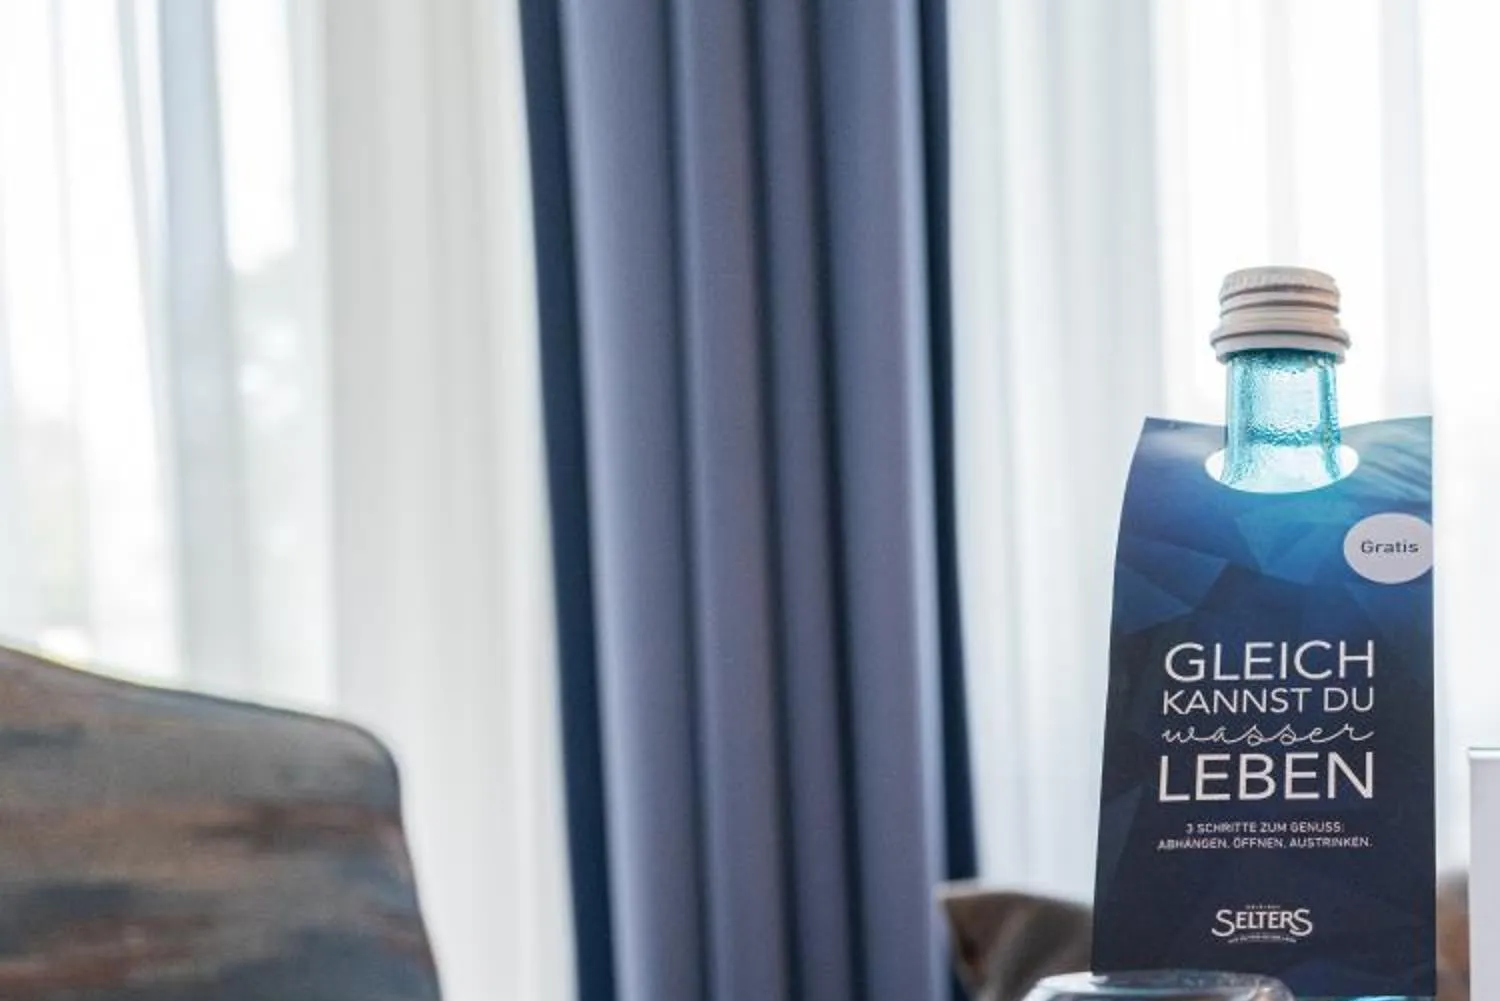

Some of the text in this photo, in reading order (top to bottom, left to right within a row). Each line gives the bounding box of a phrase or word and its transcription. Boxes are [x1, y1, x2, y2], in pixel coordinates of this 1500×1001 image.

[1361, 539, 1419, 553] Gratis
[1165, 639, 1374, 682] GLEICH
[1163, 686, 1374, 715] KANNST DU
[1161, 723, 1375, 747] wasser
[1158, 751, 1374, 801] LEBEN
[1186, 821, 1345, 834] 3 SCHRITTE ZUM GENUSS:
[1289, 836, 1373, 848] AUSTRINKEN.
[1211, 908, 1313, 937] SELTERS
